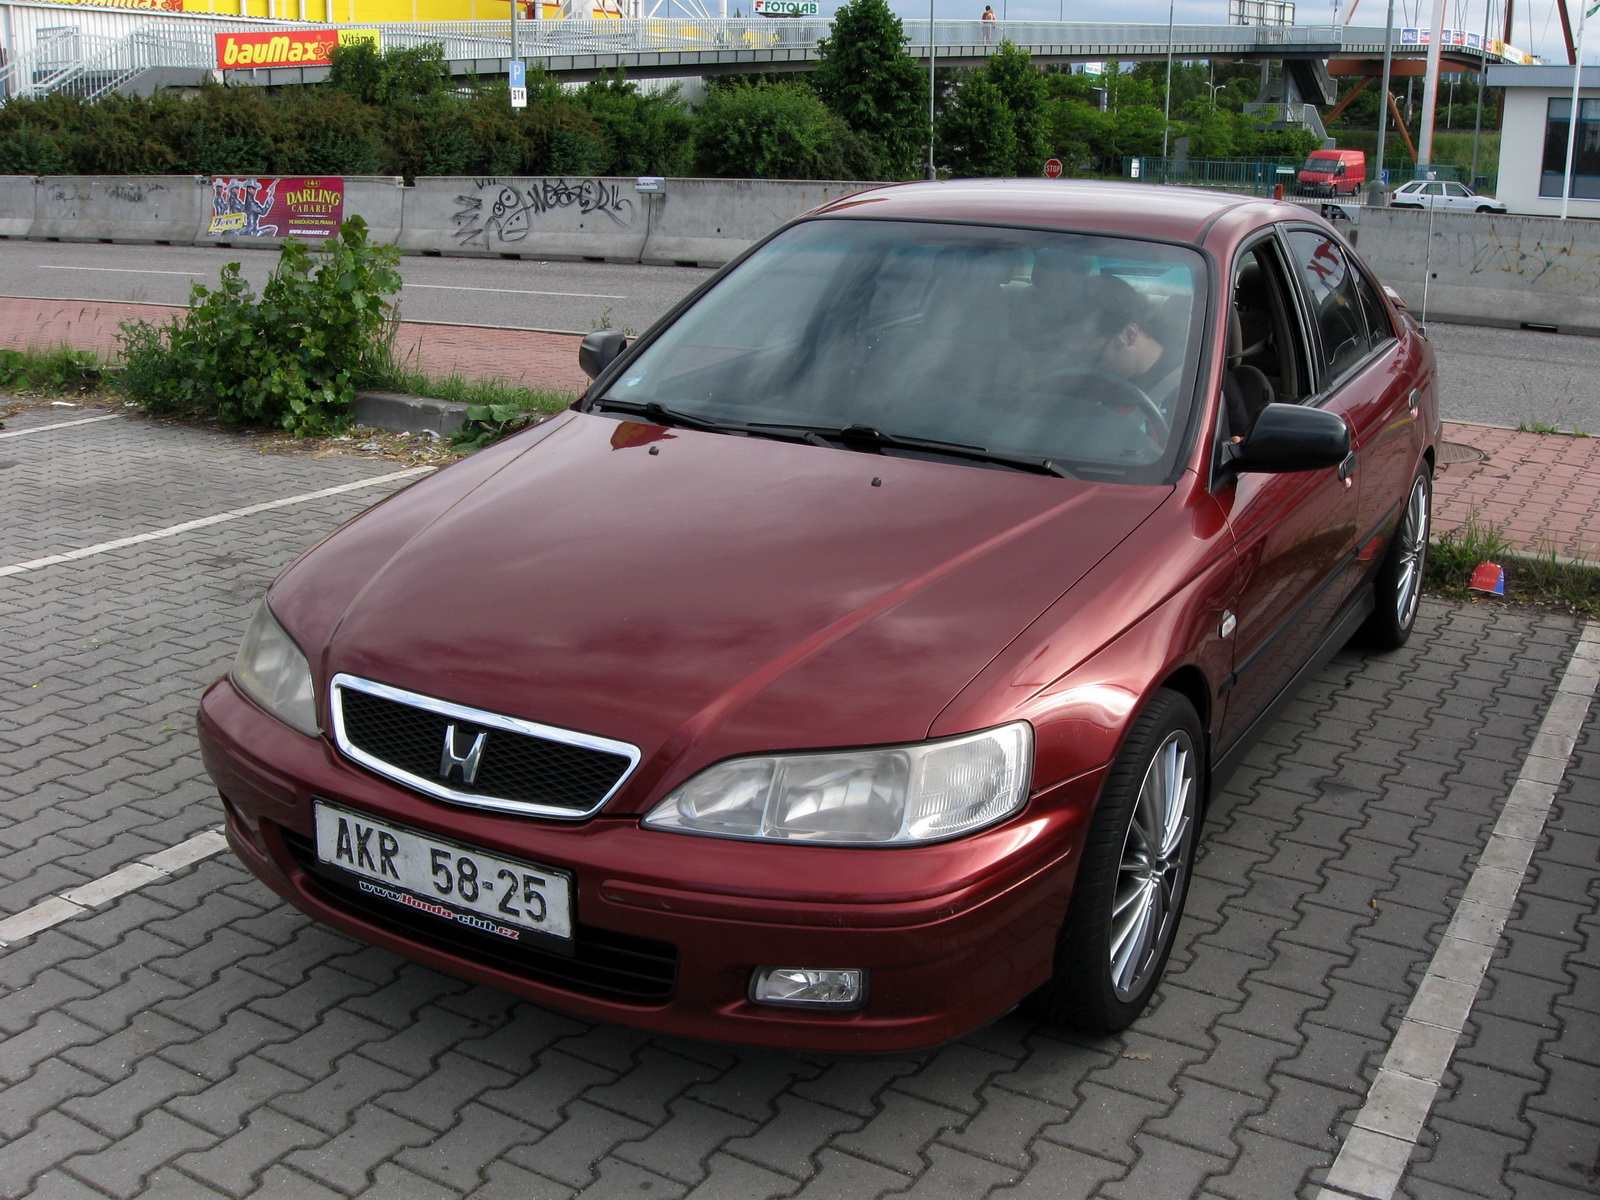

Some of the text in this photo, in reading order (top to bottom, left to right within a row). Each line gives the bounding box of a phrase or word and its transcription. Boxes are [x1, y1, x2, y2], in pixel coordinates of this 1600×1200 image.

[765, 1, 817, 14] FOTOLAB
[513, 64, 521, 81] P
[513, 89, 525, 101] STK
[1046, 164, 1060, 173] STOP
[286, 188, 342, 206] DARLING
[291, 204, 333, 213] CABARET
[335, 816, 548, 923] AKR 58-25
